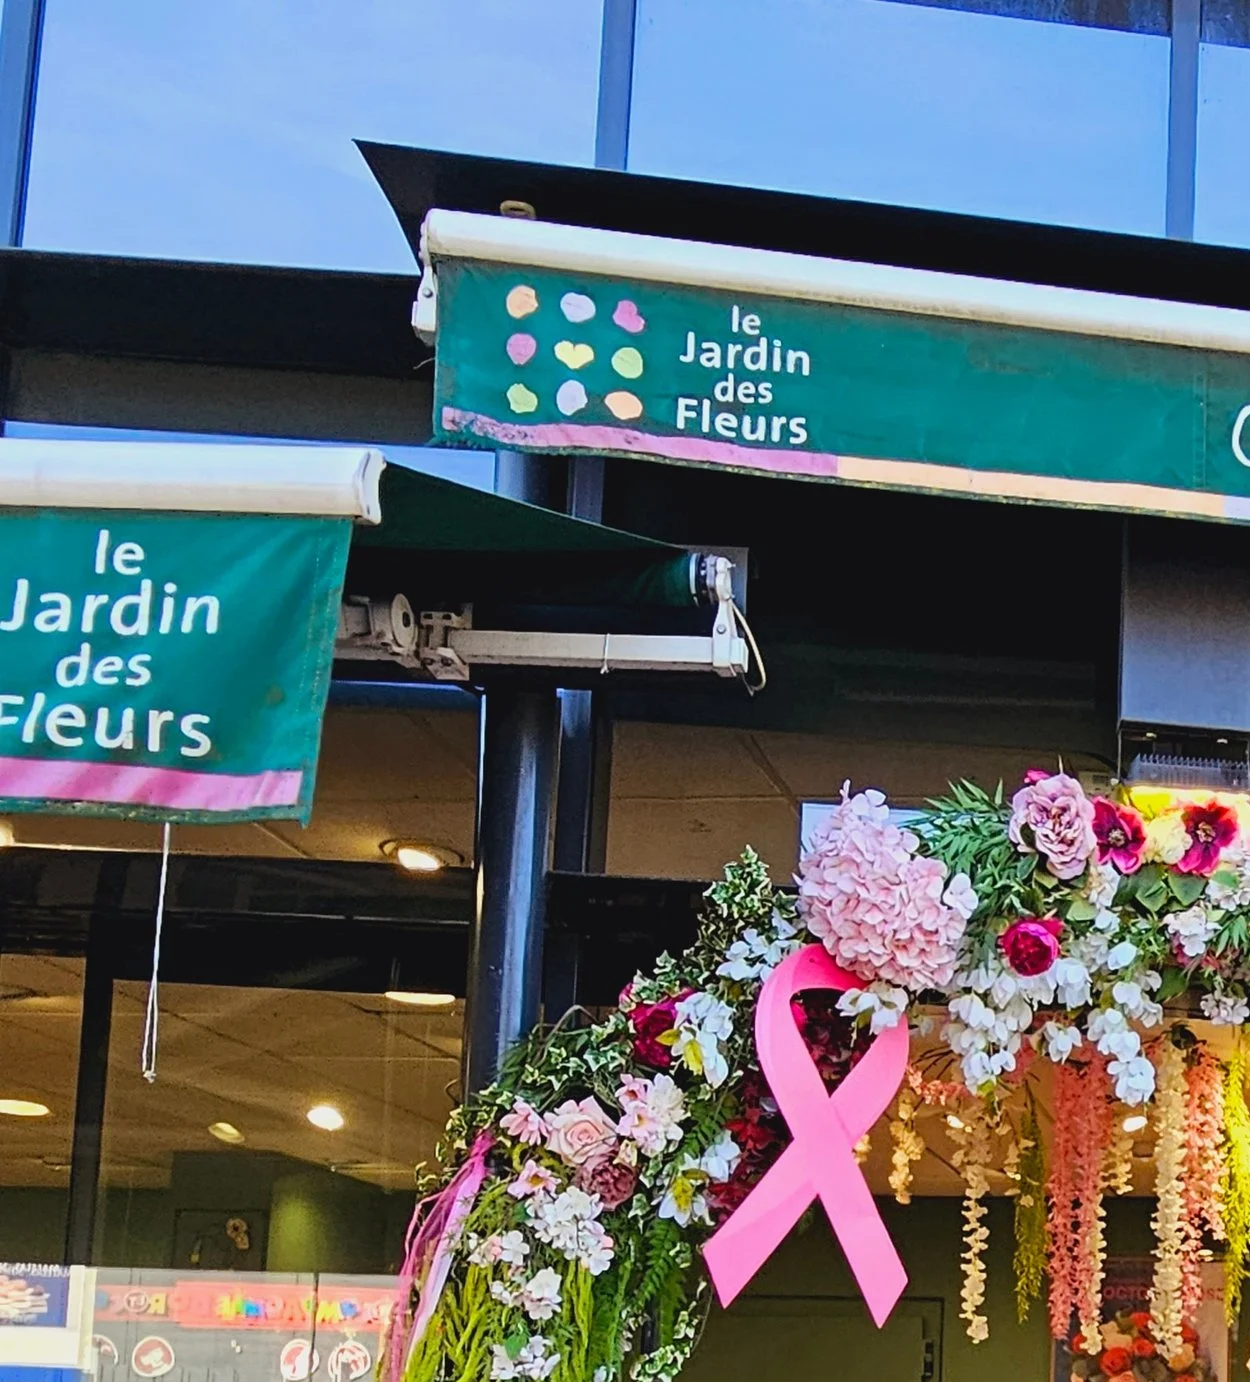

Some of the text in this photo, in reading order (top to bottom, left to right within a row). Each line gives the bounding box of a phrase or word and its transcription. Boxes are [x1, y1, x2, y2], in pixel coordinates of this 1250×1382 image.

[730, 305, 761, 336] le
[679, 331, 811, 377] Jardin
[713, 373, 773, 405] des
[676, 397, 808, 444] Fleurs
[95, 529, 145, 576] le
[0, 578, 220, 636] Jardin
[55, 642, 152, 688] des
